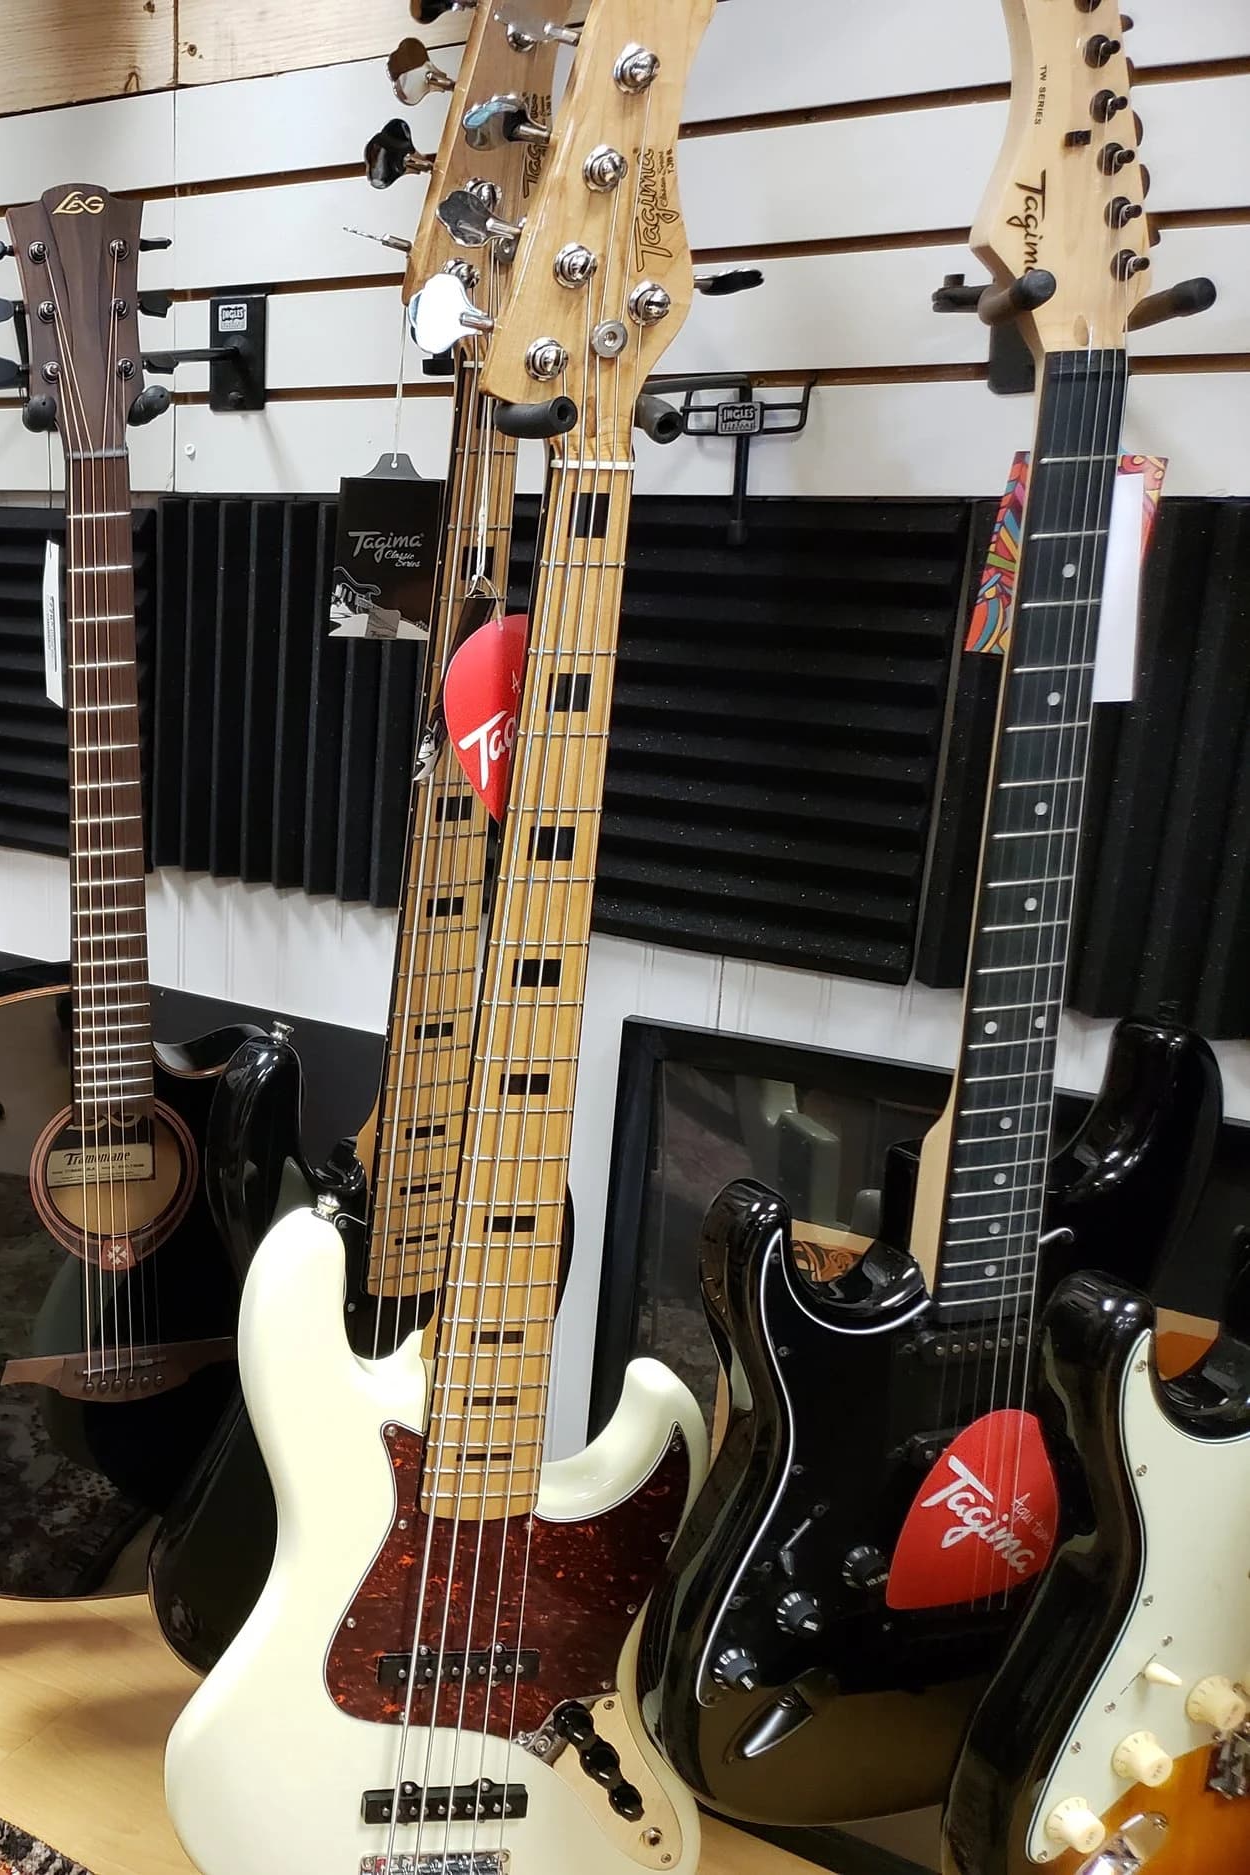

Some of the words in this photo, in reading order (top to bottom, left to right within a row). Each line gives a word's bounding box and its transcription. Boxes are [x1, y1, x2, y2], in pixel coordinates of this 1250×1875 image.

[1039, 64, 1047, 81] TW
[1034, 86, 1047, 125] SERIES
[632, 148, 679, 272] Tagima
[348, 530, 423, 563] Tagima
[384, 550, 415, 560] Classic
[395, 559, 421, 568] Series
[921, 1455, 1035, 1574] Tagima
